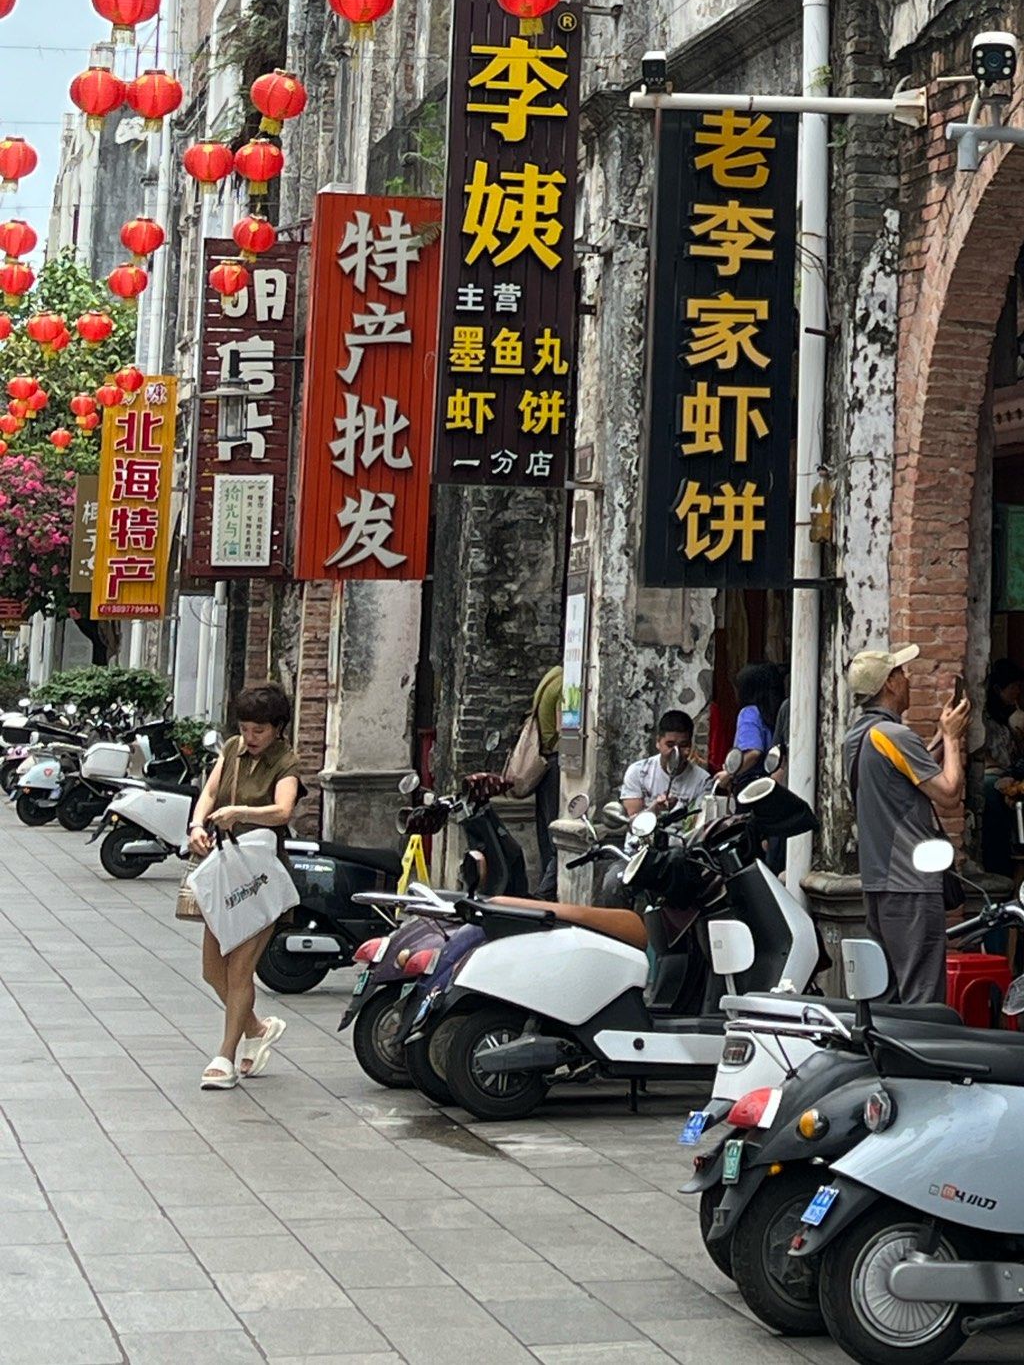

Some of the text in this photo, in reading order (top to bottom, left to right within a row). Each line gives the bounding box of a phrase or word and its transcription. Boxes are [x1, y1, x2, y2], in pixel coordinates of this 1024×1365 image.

[463, 36, 570, 271] 李姨
[449, 326, 570, 376] 墨鱼丸
[455, 282, 522, 314] 主营
[676, 109, 776, 562] 老李家虾饼
[323, 208, 423, 569] 特产批发
[445, 388, 567, 436] 虾饼
[106, 409, 164, 602] 北海特产
[452, 450, 554, 478] 一分店
